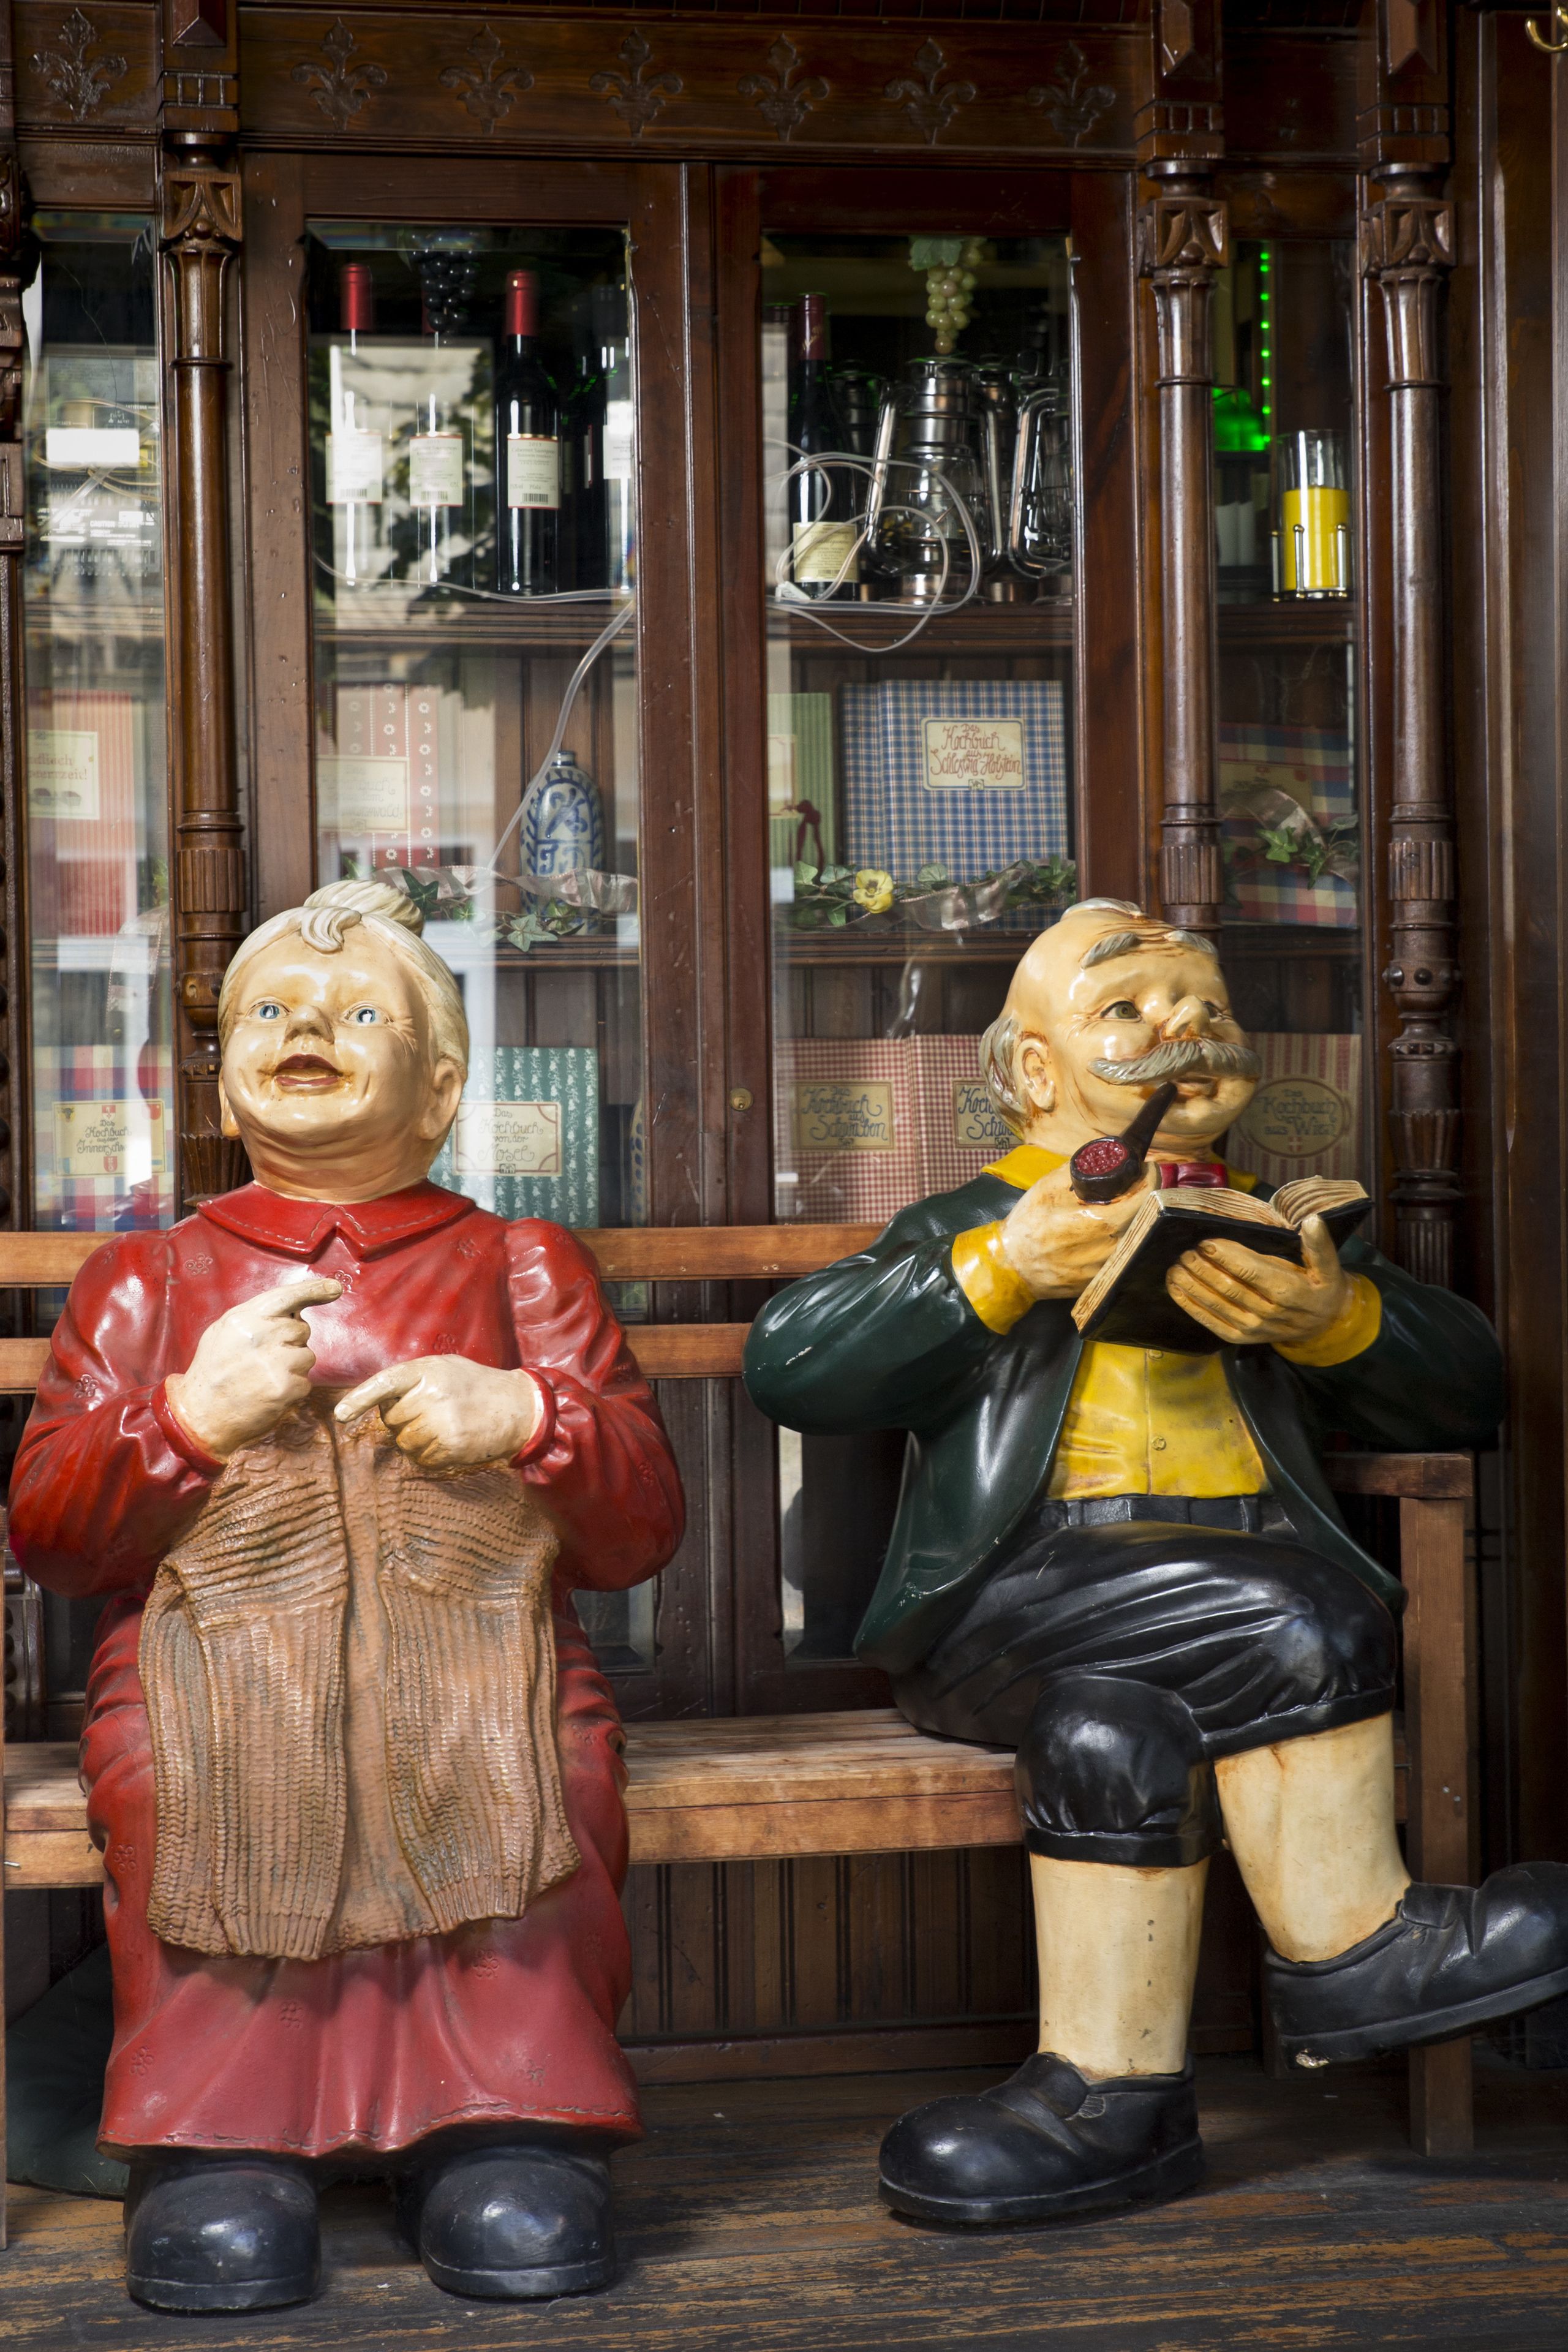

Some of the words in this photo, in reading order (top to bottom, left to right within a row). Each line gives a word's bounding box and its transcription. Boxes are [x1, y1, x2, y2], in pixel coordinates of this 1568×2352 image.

[961, 723, 980, 733] Das
[941, 725, 1006, 751] Kochbuch
[966, 750, 982, 758] aus
[957, 1086, 995, 1114] Koch
[494, 1107, 513, 1118] Das
[85, 1126, 132, 1138] Kochbuch
[478, 1117, 544, 1135] Kochbuch
[477, 1143, 535, 1162] Mosel
